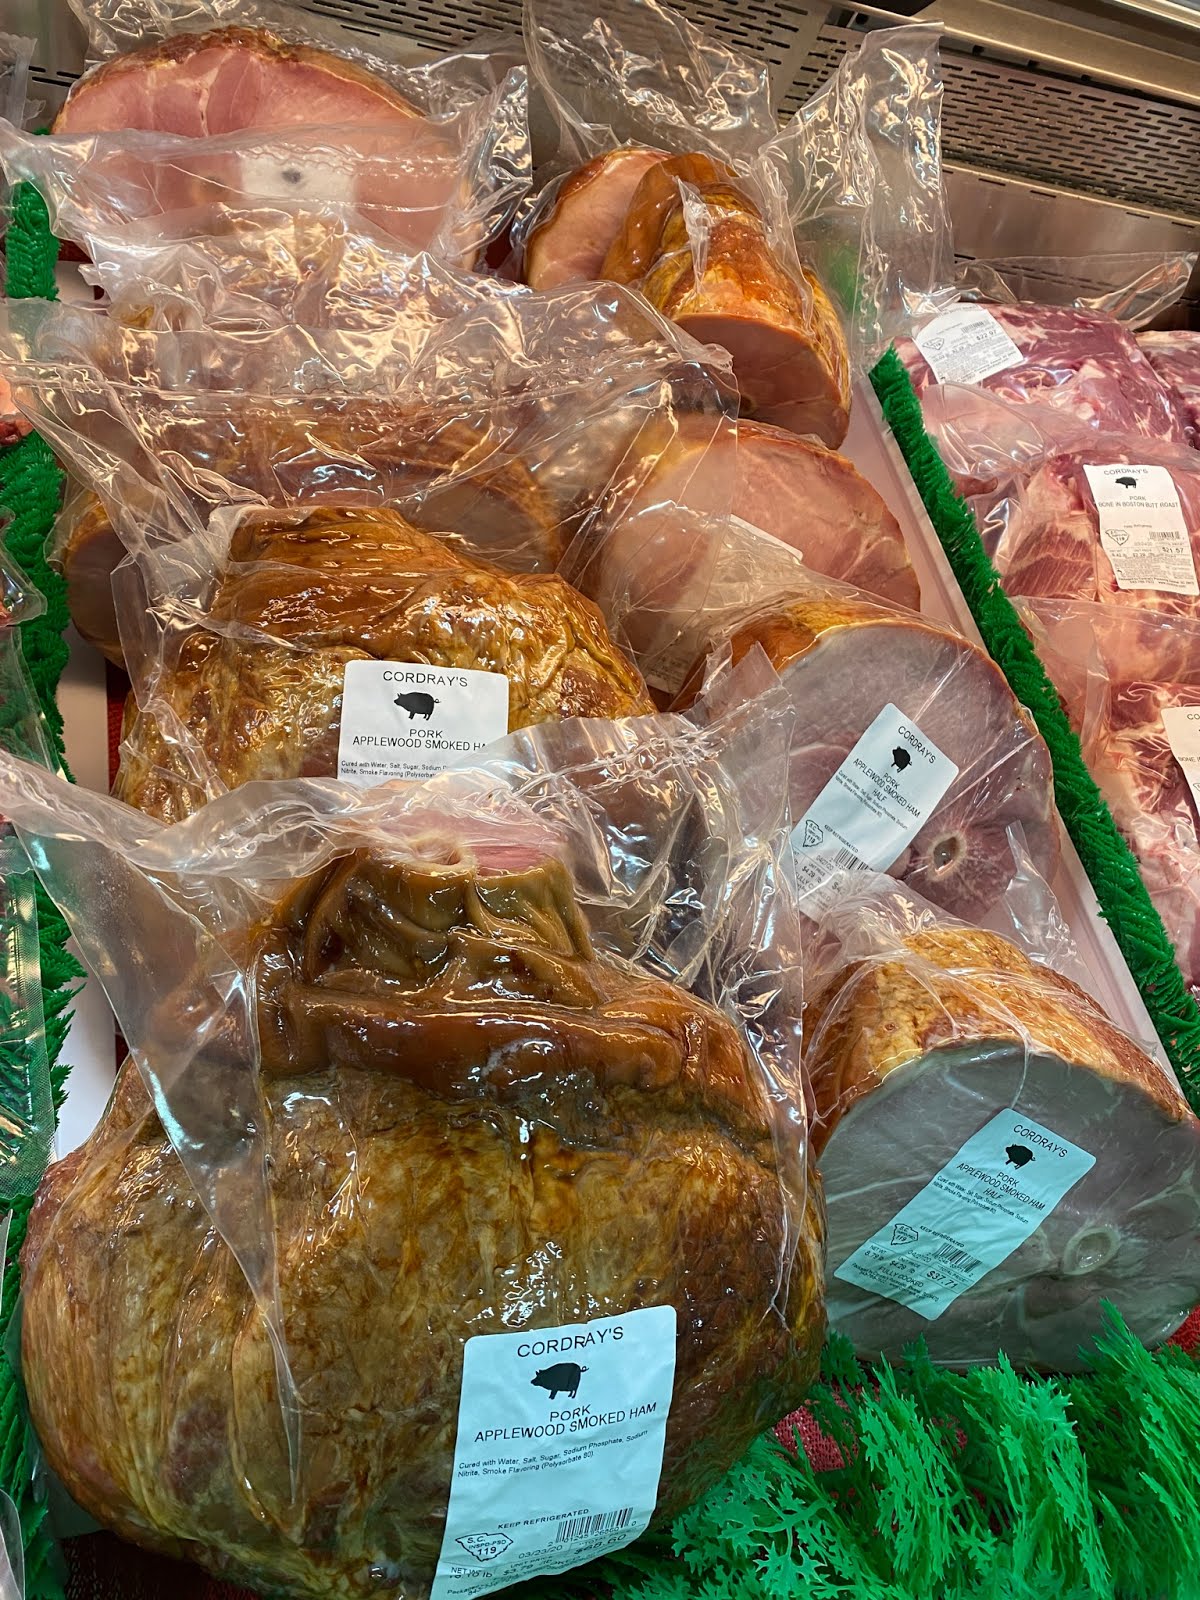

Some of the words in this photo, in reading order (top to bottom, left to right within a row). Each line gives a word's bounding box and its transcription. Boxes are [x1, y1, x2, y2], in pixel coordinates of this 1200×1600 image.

[383, 670, 468, 687] CORDRAY'S
[409, 729, 443, 739] PORK
[352, 736, 421, 748] APPLEWOOD
[425, 740, 470, 750] SMOKED
[898, 726, 936, 764] CORDRAY'S
[853, 758, 885, 788] APPLEWOOD
[884, 785, 908, 807] SMOKED
[905, 803, 921, 818] HAM
[882, 773, 900, 789] PORK
[872, 789, 887, 802] HALF
[807, 835, 815, 844] 119
[1013, 1124, 1068, 1158] CORDRAY'S
[957, 1163, 1000, 1187] APPLEWOOD
[1000, 1182, 1031, 1204] SMOKED
[1028, 1199, 1045, 1211] HAM
[996, 1172, 1020, 1187] PORK
[983, 1188, 1002, 1200] HALF
[896, 1234, 907, 1242] 119
[879, 1266, 899, 1279] FULLY
[898, 1274, 924, 1288] COOKED
[926, 1270, 958, 1289] $37.71
[517, 1326, 624, 1357] CORDRAY'S
[550, 1404, 591, 1422] PORK
[474, 1424, 565, 1442] APPLEWOOD
[569, 1410, 626, 1432] SMOKED
[629, 1402, 657, 1420] HAM
[459, 1461, 480, 1470] Cured
[482, 1459, 496, 1467] with
[498, 1458, 520, 1466] Water,
[523, 1456, 538, 1464] Salt,
[540, 1453, 561, 1463] Sugar,
[563, 1445, 587, 1455] Sodium
[588, 1438, 624, 1451] Phosphate,
[626, 1430, 648, 1442] Sodium
[457, 1470, 480, 1478] Nitrite,
[482, 1467, 507, 1475] Smoke
[508, 1464, 540, 1474] Flavoring
[541, 1455, 581, 1470] (Polysorbate
[523, 1508, 589, 1526] REFRIGERATED
[467, 1536, 485, 1544] S.C.
[574, 1534, 626, 1554] $68.60
[477, 1547, 497, 1555] 119
[518, 1544, 563, 1559] 03/23/20
[503, 1564, 534, 1575] $3.79
